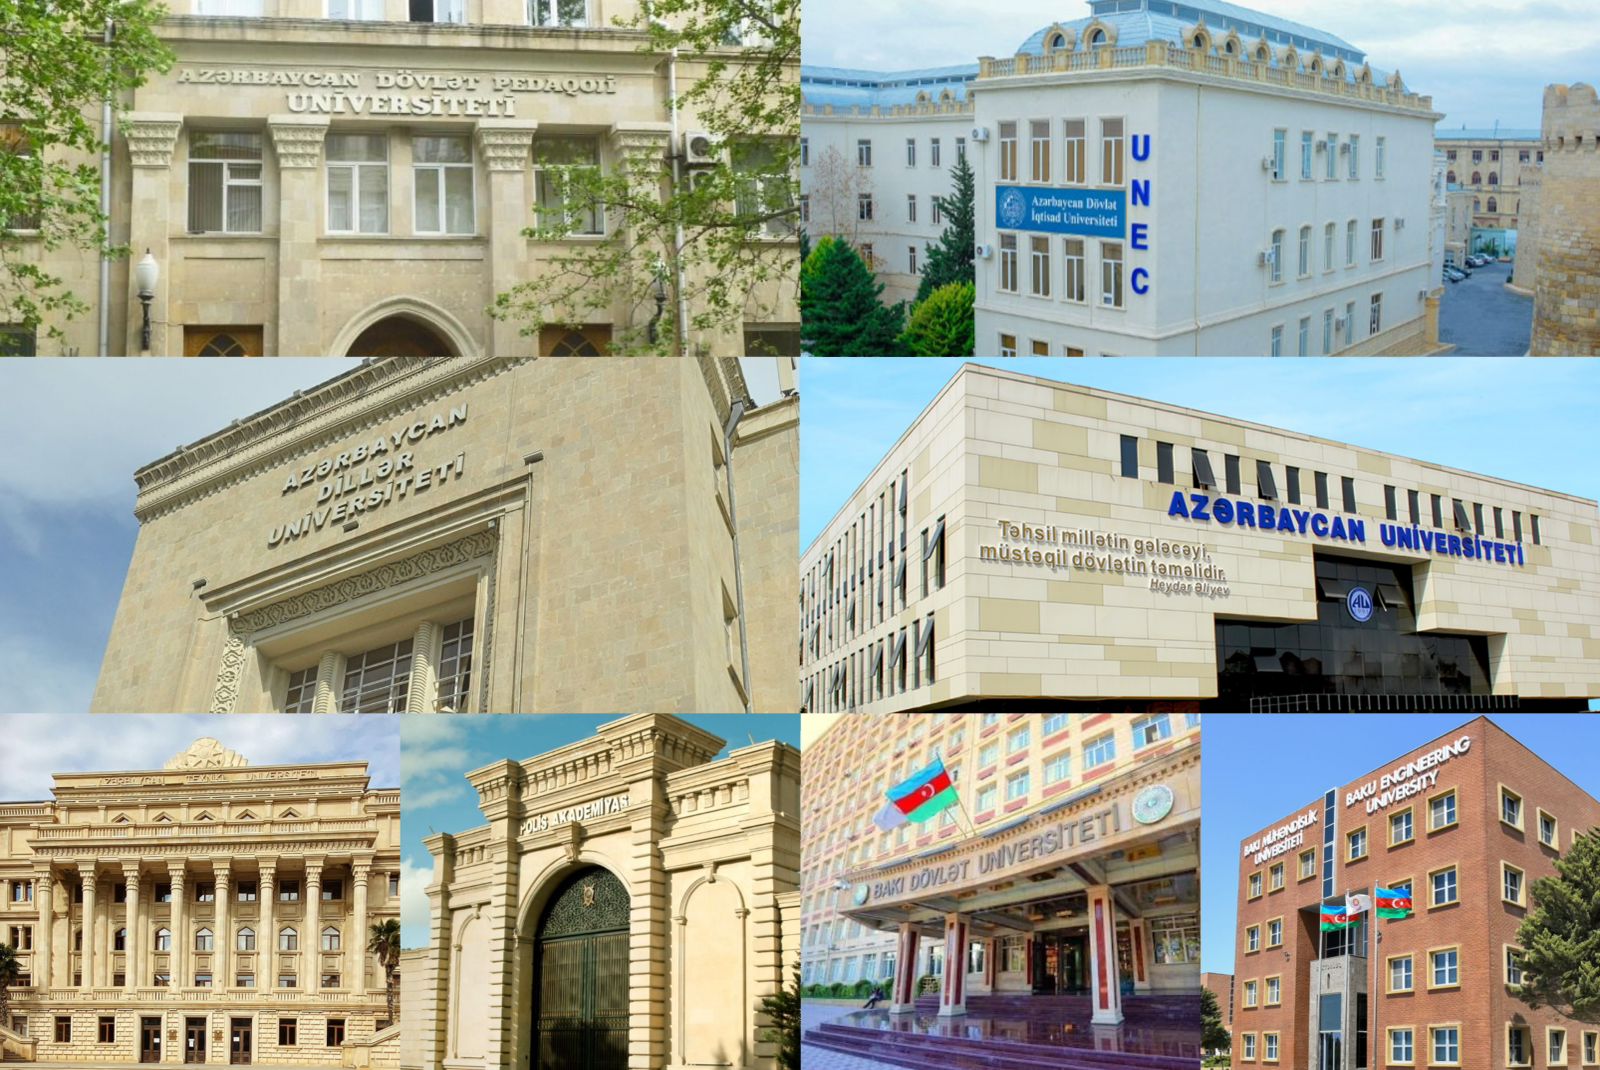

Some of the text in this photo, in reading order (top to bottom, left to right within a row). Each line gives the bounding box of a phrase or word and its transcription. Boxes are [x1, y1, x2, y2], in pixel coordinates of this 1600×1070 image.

[177, 69, 361, 88] AZƏRBAYCAN
[375, 69, 480, 92] DÖVLƏT
[286, 91, 517, 118] UNİVERSİTETİ
[1063, 211, 1118, 228] Universiteti
[1131, 134, 1150, 295] UNEC
[282, 402, 468, 495] AZƏRBAYCAN
[268, 450, 466, 549] UNİVERSİTETİ
[317, 451, 414, 505] DİLLƏR
[999, 519, 1211, 562] Təhsil millətin gələcəyi,
[1168, 491, 1525, 566] AZƏRBAYCAN UNİVERSİTETİ
[980, 543, 1227, 581] müstəqil dövlətin təməlidir.
[1345, 735, 1472, 808] BAKU ENGINEERING
[1366, 769, 1439, 816] UNIVERSITY
[520, 814, 548, 835] POLİS
[1244, 838, 1261, 858] BAKI
[874, 802, 1120, 898] BAKI DÖVLƏT UNİVERSİTETİ
